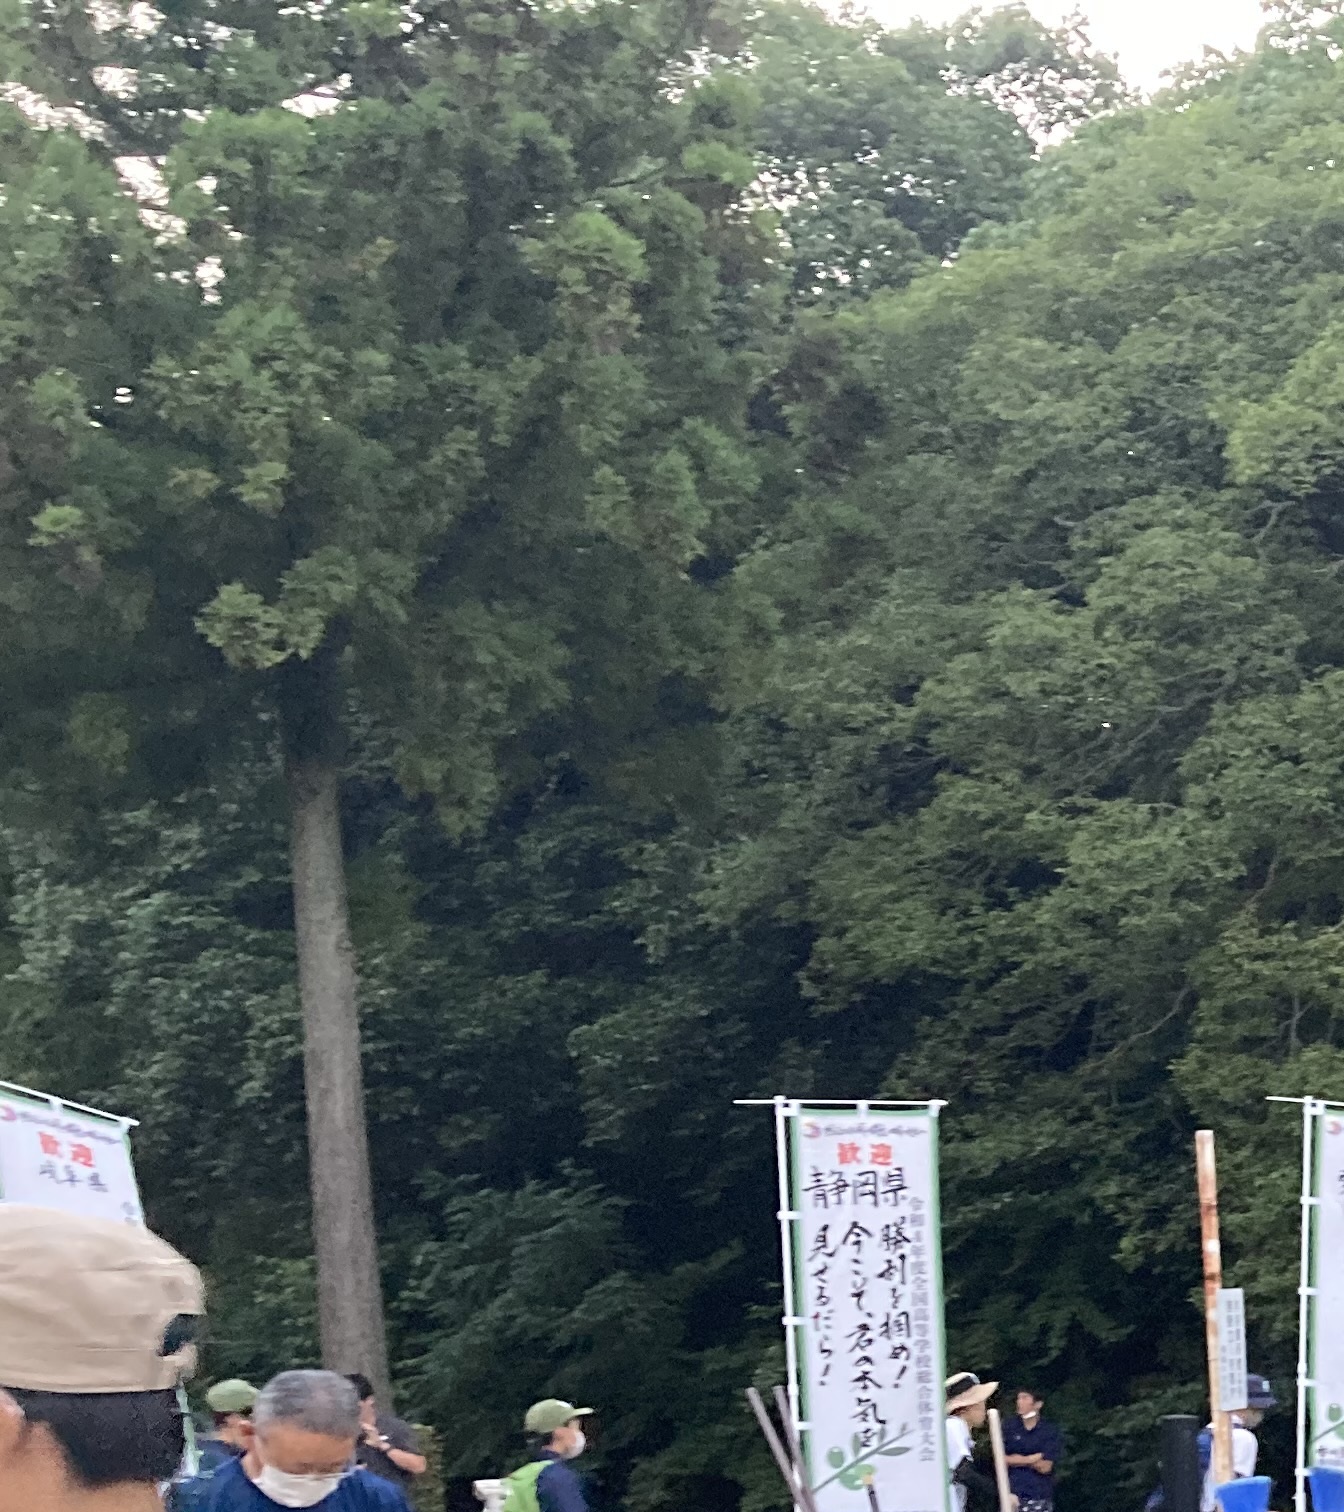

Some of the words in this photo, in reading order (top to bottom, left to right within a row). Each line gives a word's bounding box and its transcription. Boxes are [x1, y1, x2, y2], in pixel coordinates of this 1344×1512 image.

[38, 1131, 95, 1168] 歓迎
[837, 1142, 893, 1166] 歓迎
[801, 1166, 910, 1209] 静岡県
